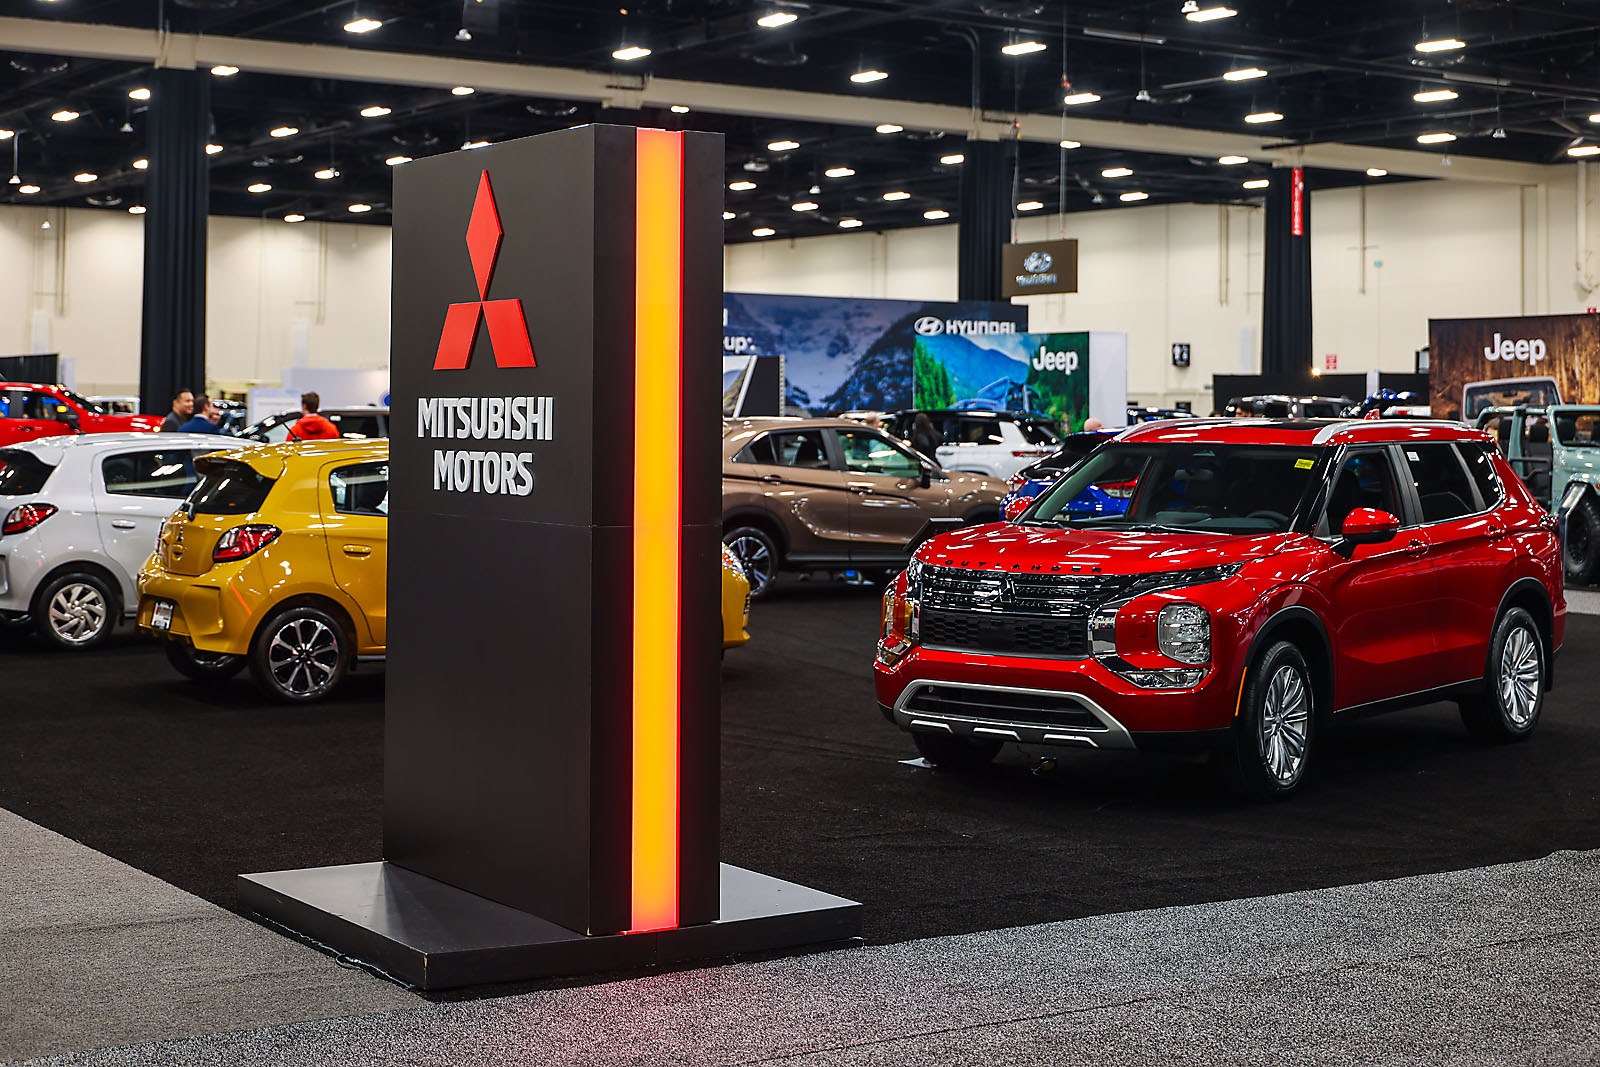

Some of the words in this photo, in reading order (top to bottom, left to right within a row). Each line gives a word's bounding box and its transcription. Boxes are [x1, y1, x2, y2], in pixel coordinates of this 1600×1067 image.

[945, 319, 1017, 335] HYUNDAI
[1032, 346, 1079, 375] Jeep
[1484, 332, 1546, 366] Jeep
[417, 397, 553, 440] MITSUBISHI
[433, 450, 533, 496] MOTORS
[945, 559, 1102, 573] OUTLANDER
